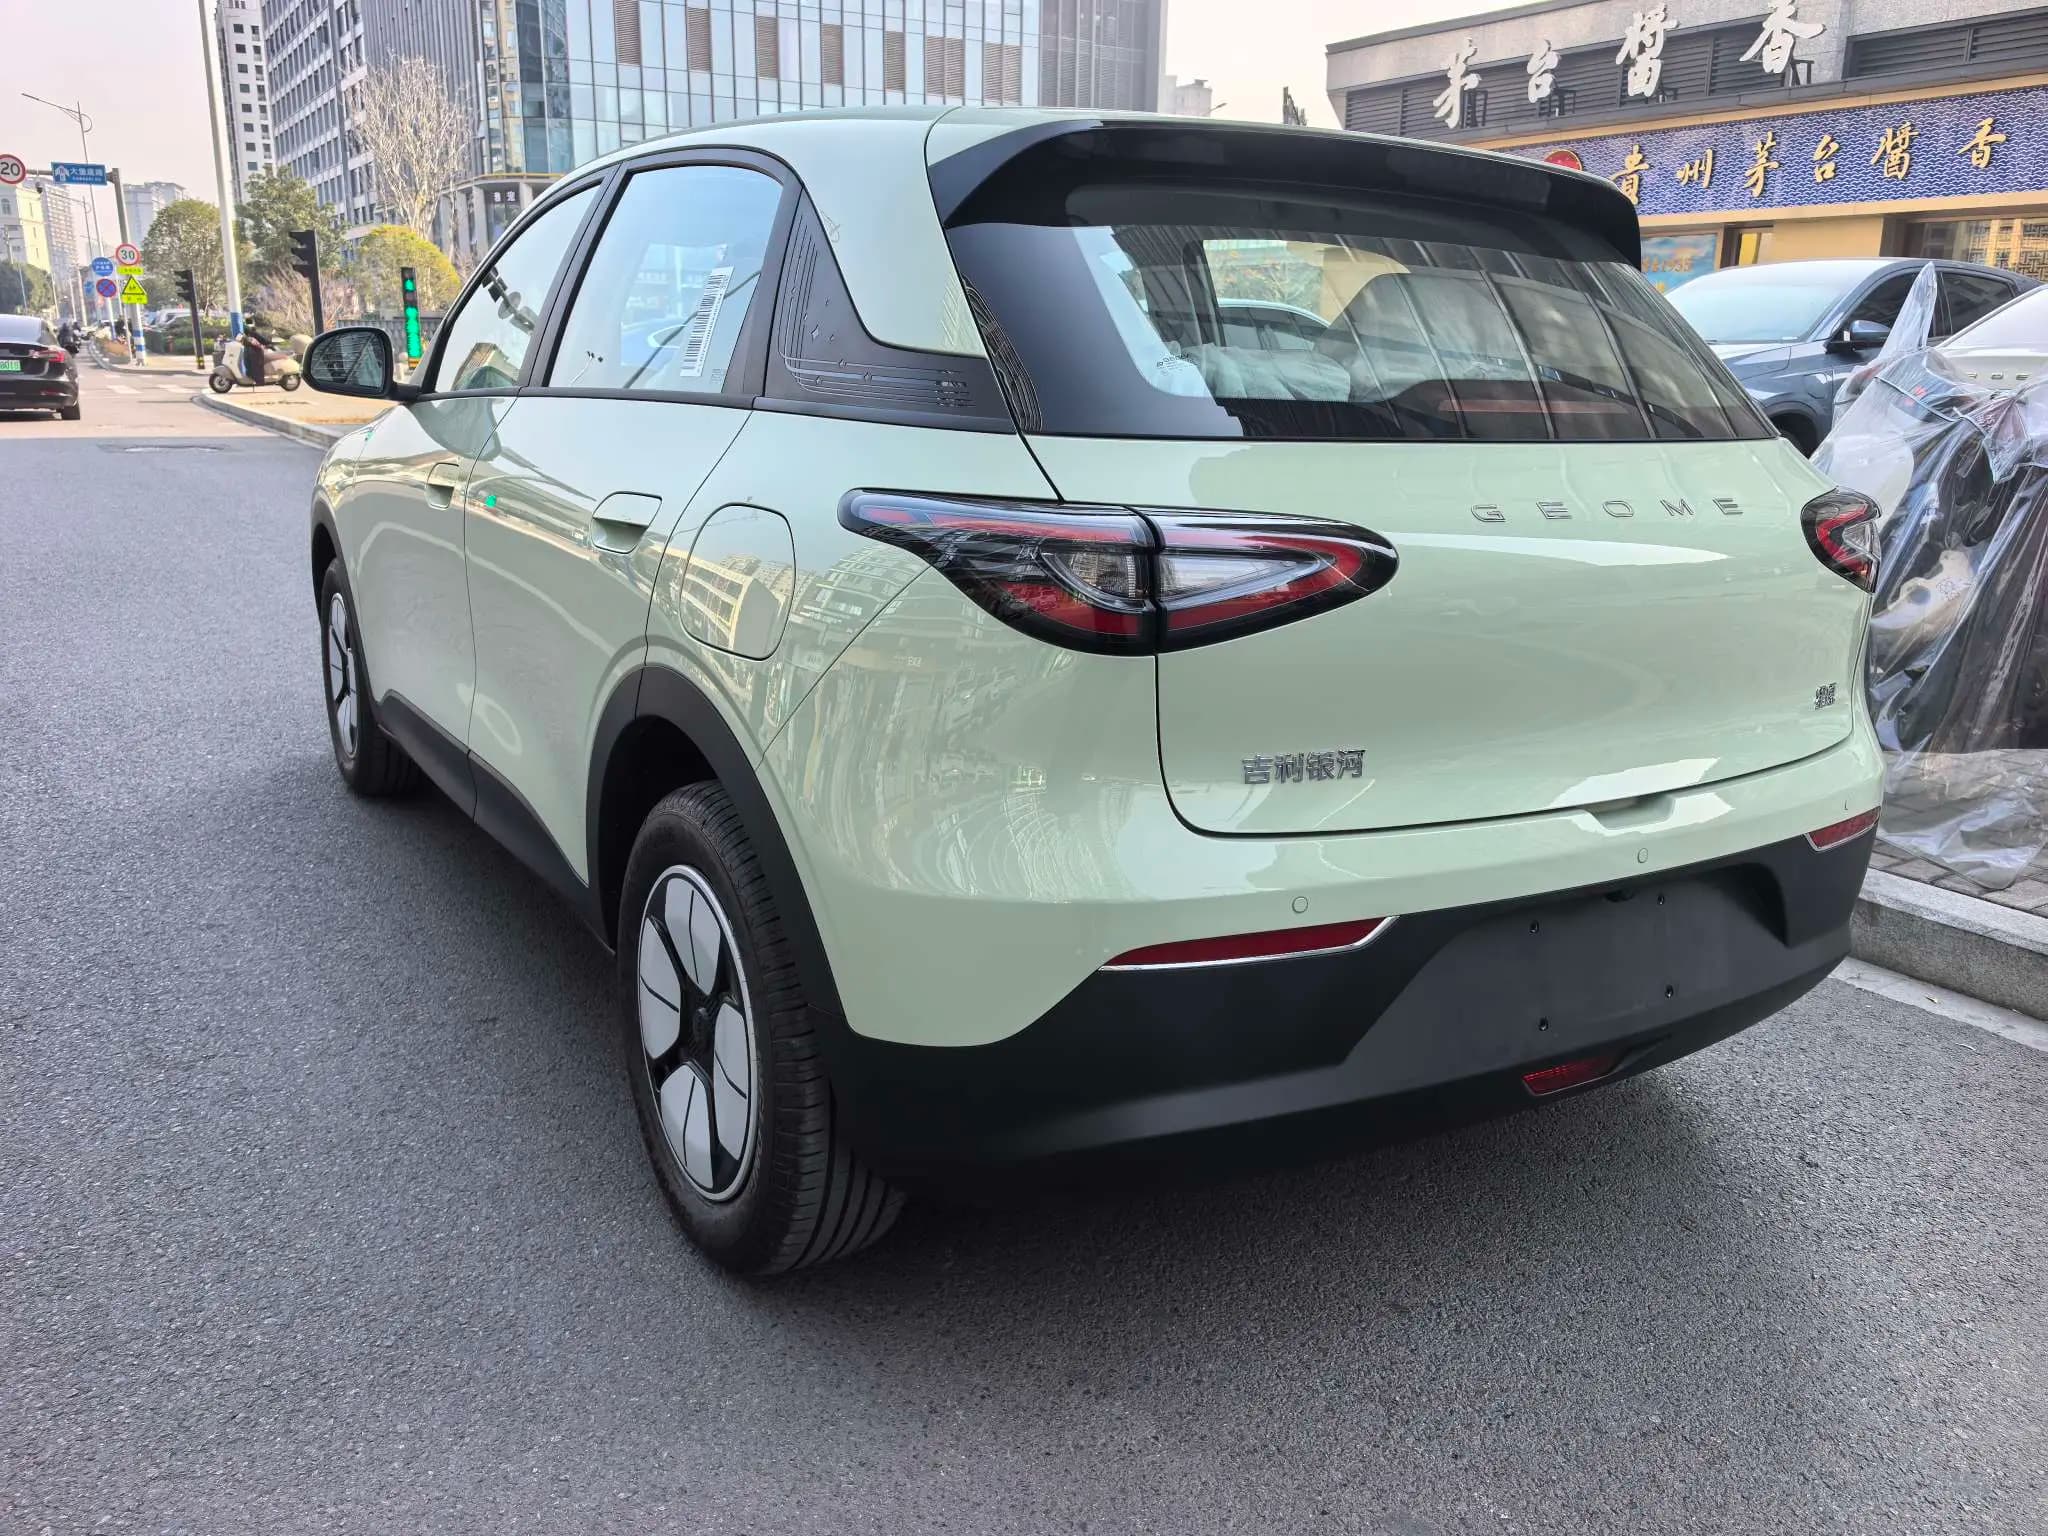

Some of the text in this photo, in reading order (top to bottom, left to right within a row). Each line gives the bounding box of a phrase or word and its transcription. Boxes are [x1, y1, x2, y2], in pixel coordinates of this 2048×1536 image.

[0, 162, 20, 176] 20
[121, 249, 135, 260] 30
[1471, 498, 1743, 523] GEOME
[1242, 749, 1366, 784] 吉利银河
